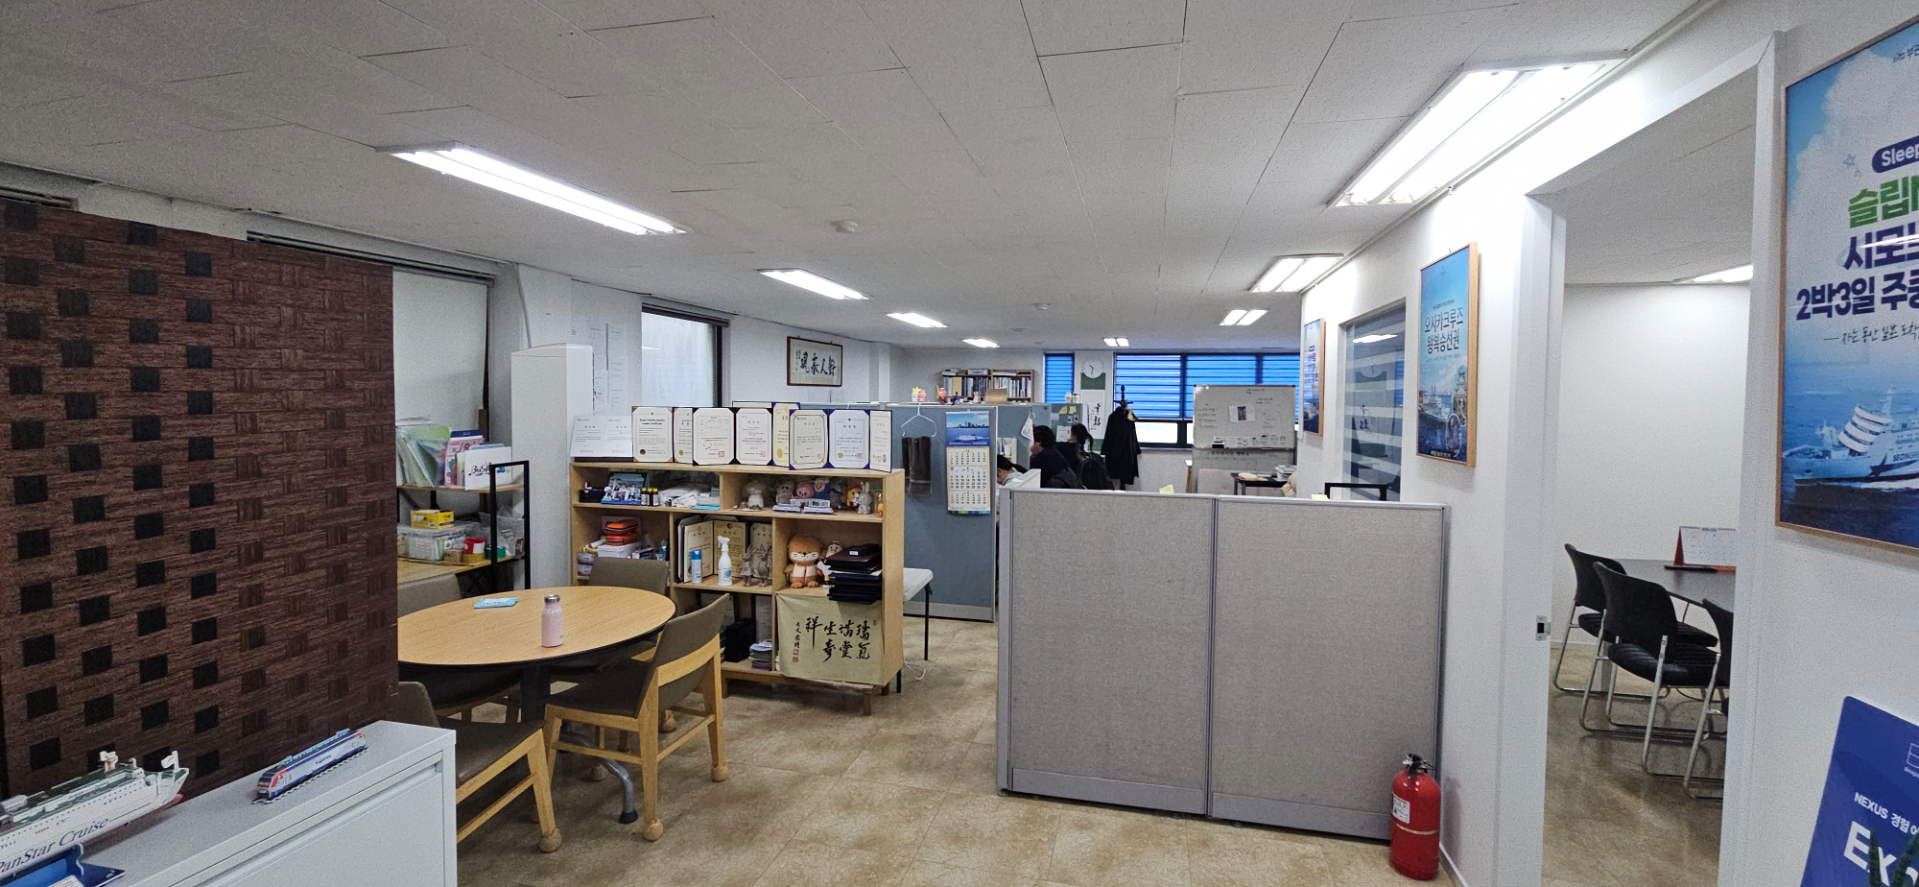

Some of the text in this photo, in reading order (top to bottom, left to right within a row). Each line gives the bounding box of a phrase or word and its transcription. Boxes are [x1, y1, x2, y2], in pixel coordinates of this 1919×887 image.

[1796, 276, 1875, 321] 2박3일
[1424, 307, 1463, 333] 오사카크루즈
[1854, 792, 1888, 819] NEXUS
[59, 818, 109, 846] Cruise
